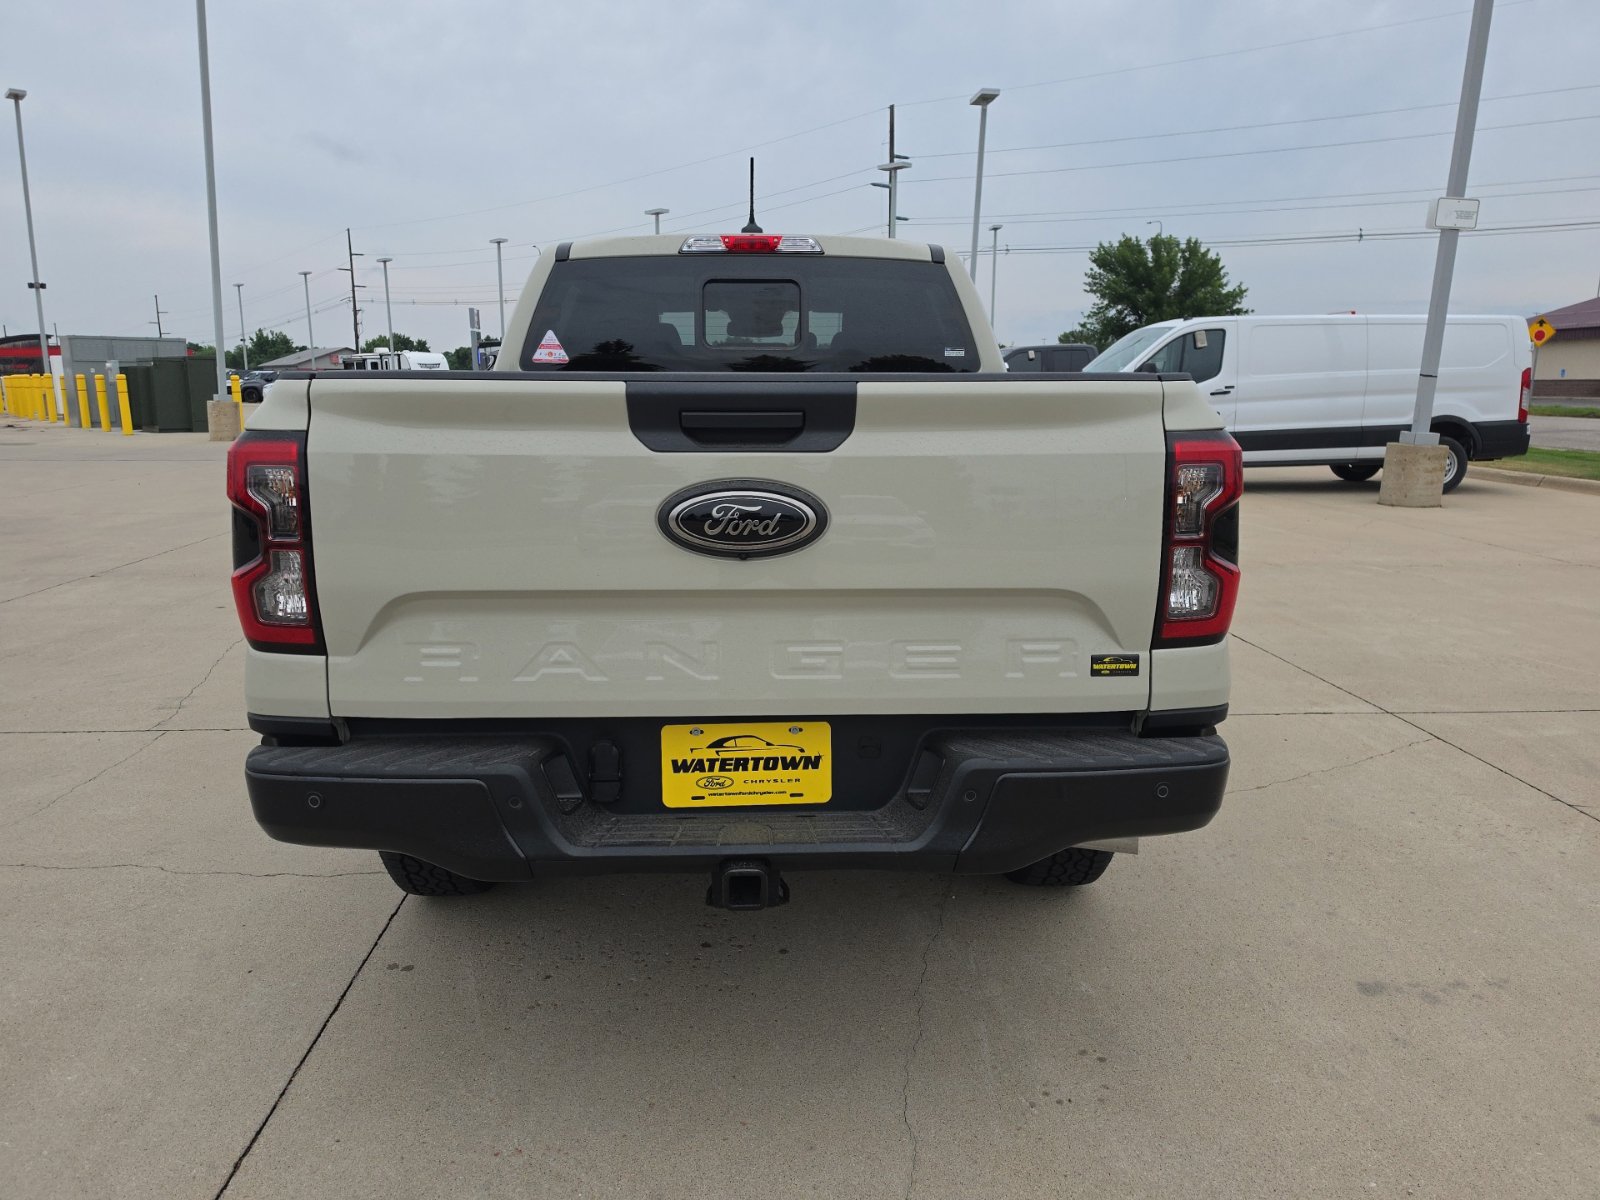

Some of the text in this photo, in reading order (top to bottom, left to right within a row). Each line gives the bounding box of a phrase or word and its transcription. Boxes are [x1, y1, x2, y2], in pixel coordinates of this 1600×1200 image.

[703, 503, 783, 536] Ford
[403, 639, 1078, 681] RANGER
[671, 755, 822, 774] WATERTOWN
[703, 777, 726, 788] Ford
